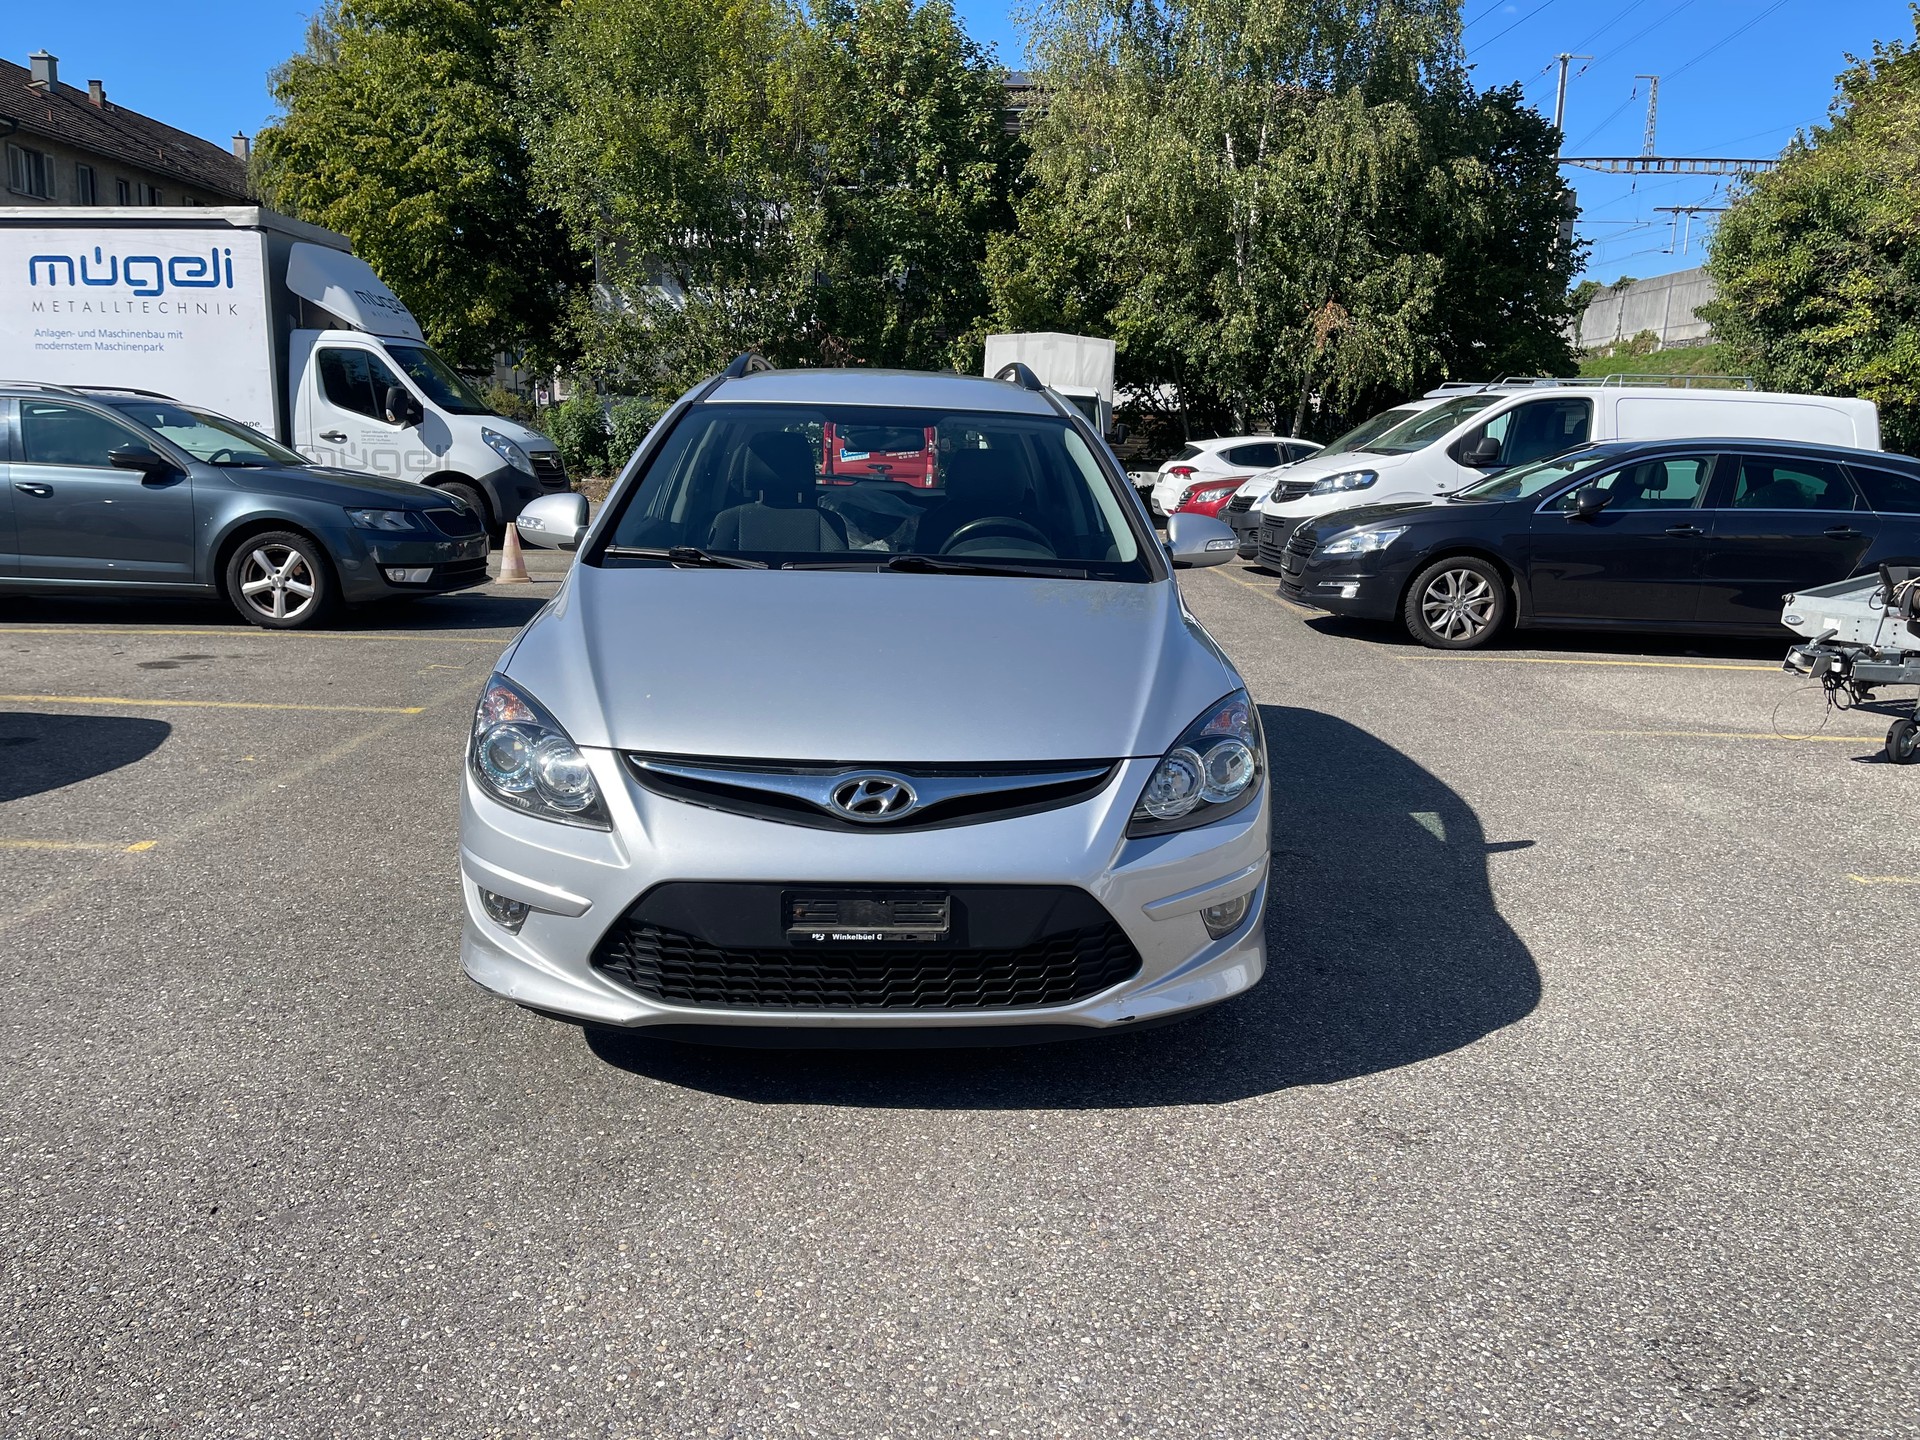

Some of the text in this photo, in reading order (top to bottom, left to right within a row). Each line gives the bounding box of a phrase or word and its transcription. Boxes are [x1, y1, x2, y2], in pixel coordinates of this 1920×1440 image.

[29, 246, 234, 297] mügeli
[31, 300, 238, 316] METALLTECHNIK
[34, 328, 183, 340] Anlagen- und Maschinenbau mit
[35, 341, 164, 354] modernstem Maschinenpark
